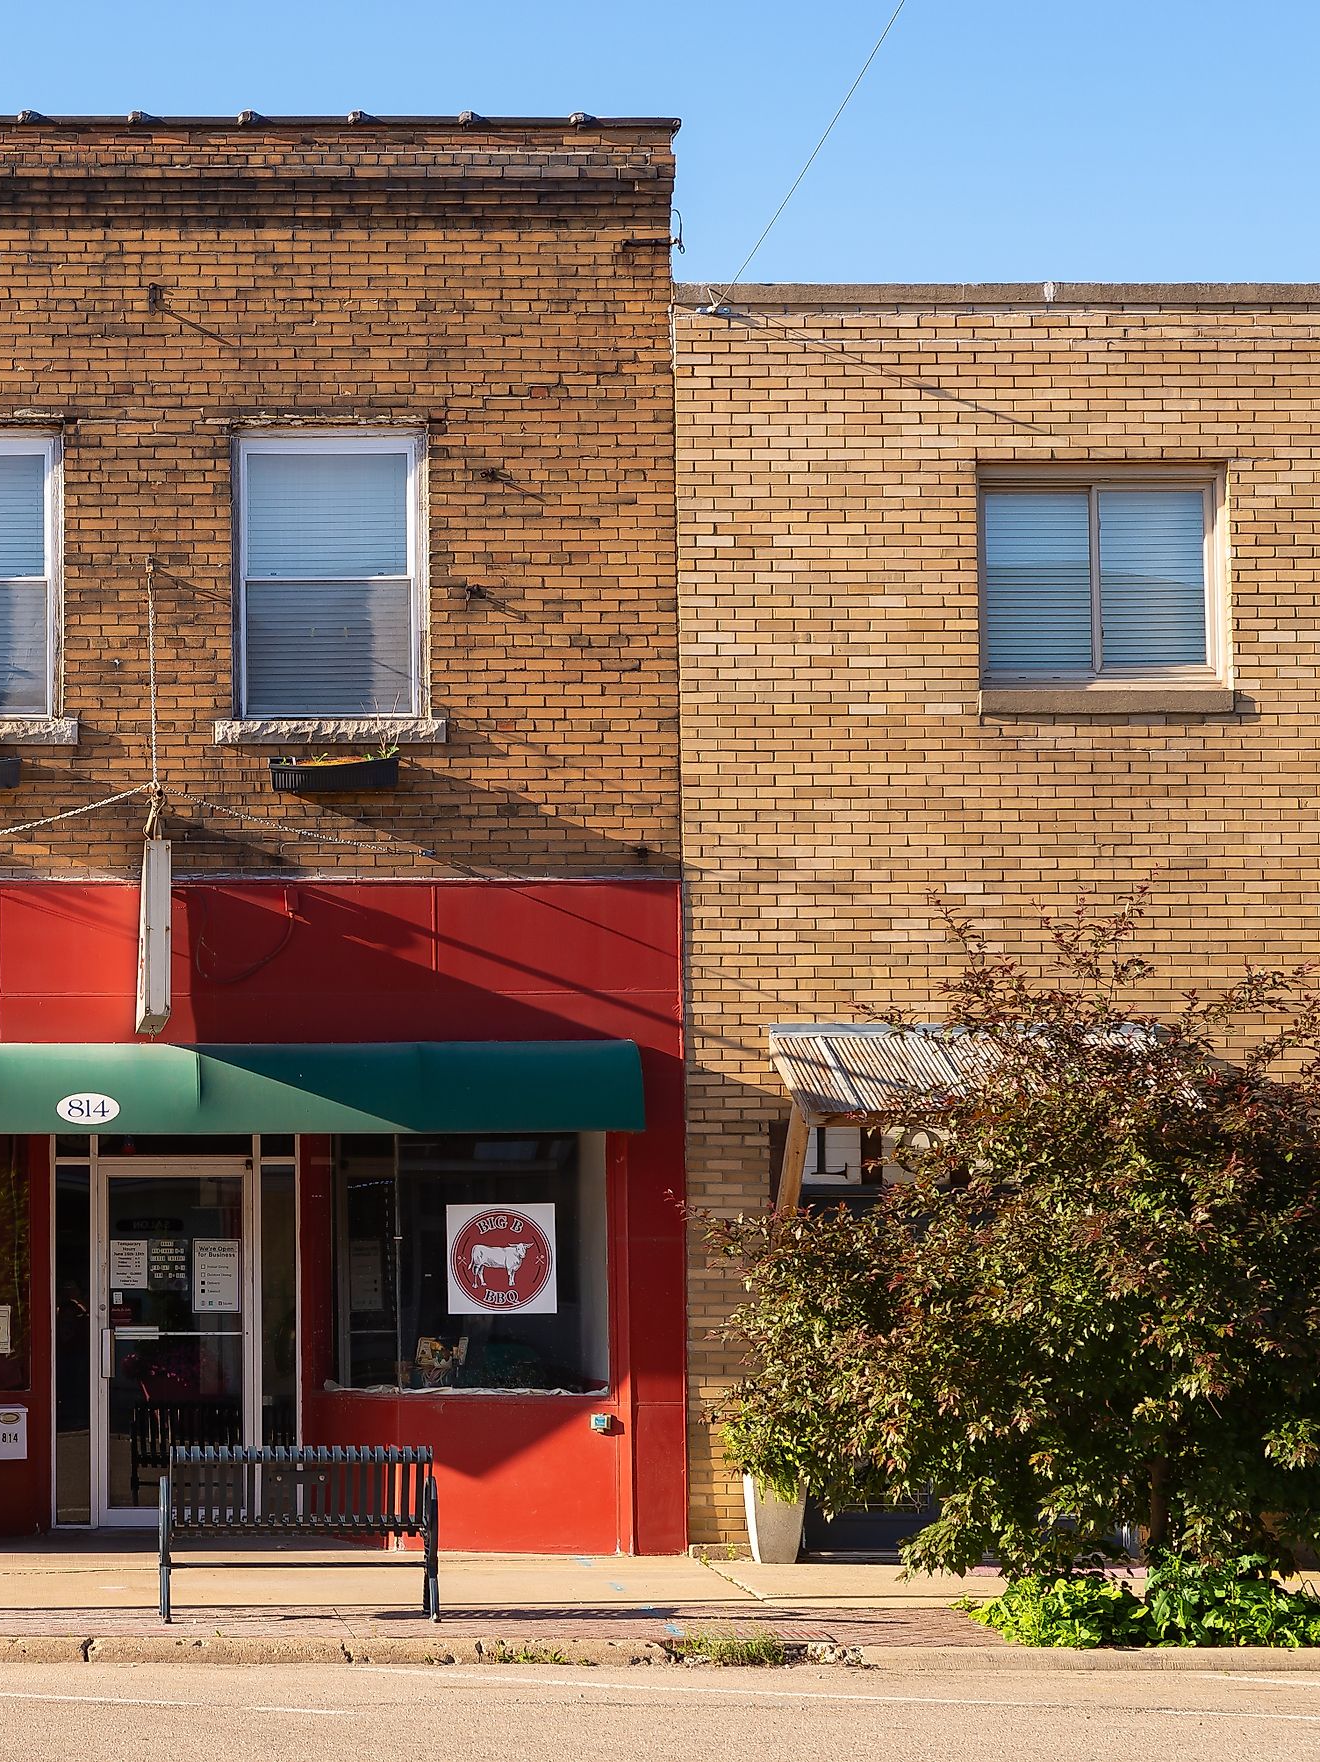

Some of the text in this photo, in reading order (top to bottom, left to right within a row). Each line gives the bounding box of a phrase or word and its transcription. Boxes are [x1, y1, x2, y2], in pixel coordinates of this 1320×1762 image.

[67, 1098, 111, 1118] 814
[475, 1215, 524, 1235] BIG B
[483, 1289, 521, 1306] BBQ
[1, 1432, 19, 1444] 814
